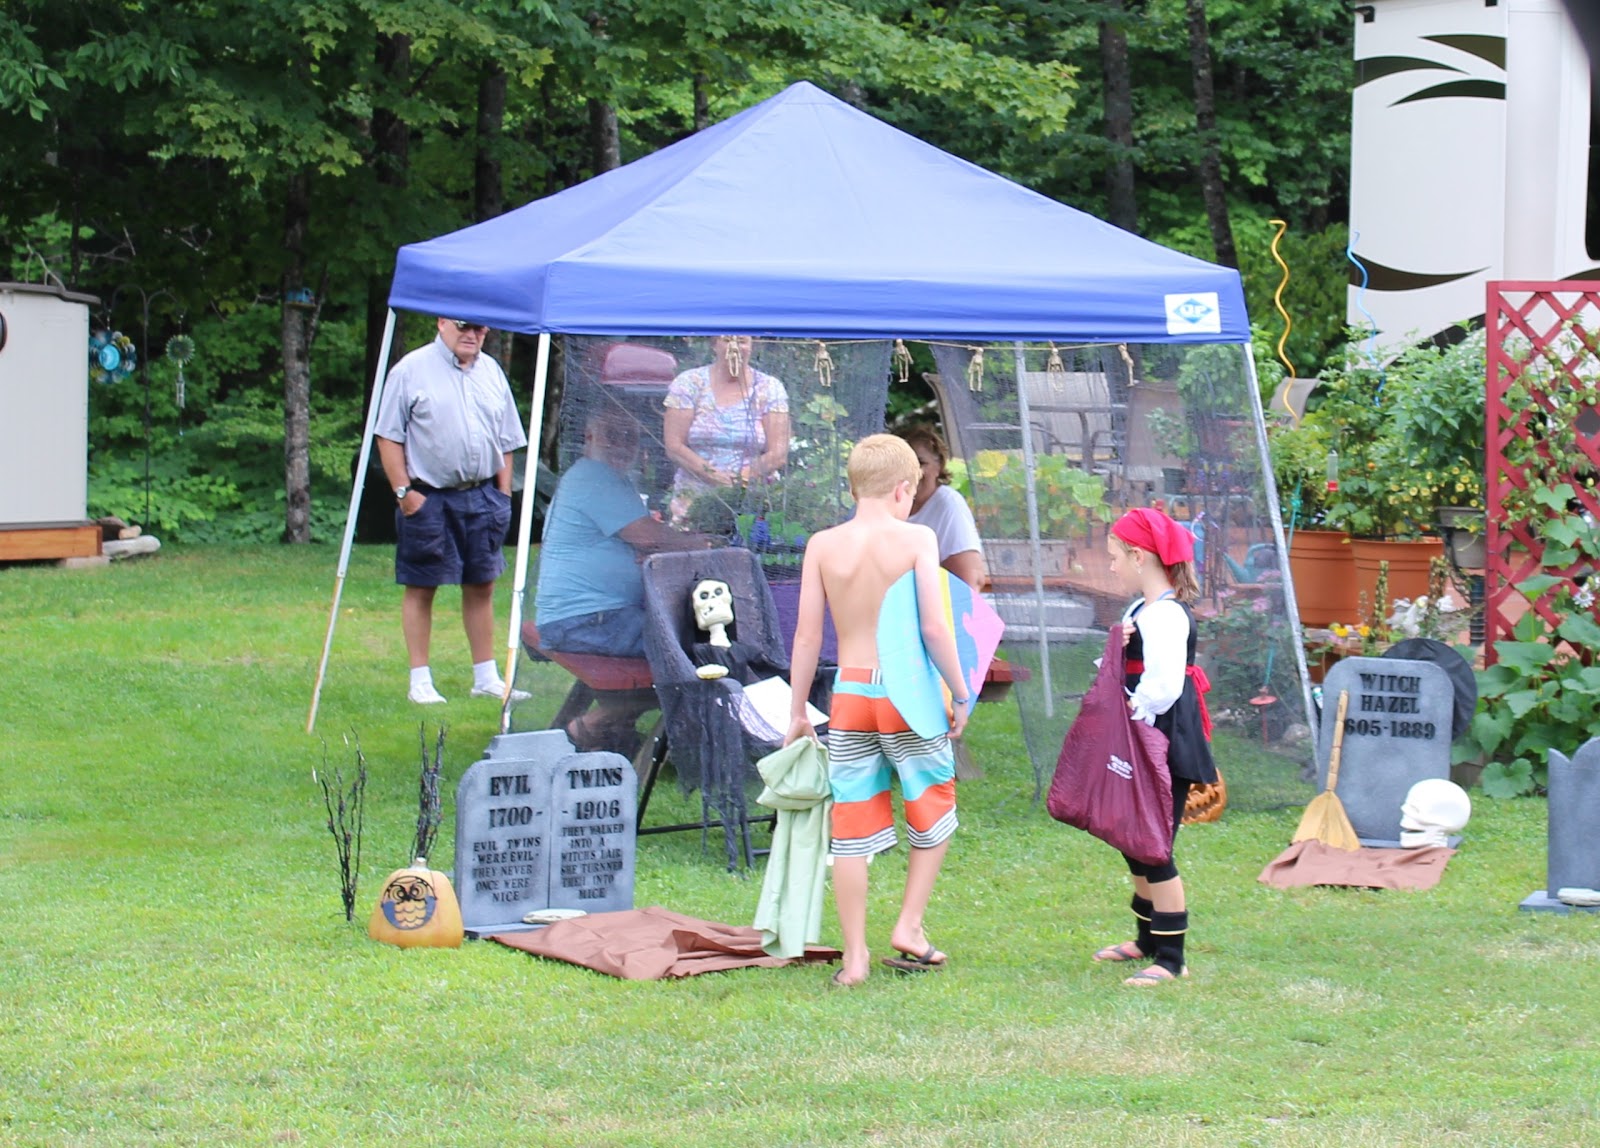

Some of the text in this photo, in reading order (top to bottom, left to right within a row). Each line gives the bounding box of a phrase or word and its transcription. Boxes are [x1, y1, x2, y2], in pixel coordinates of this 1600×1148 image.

[1359, 673, 1421, 694] WITCH
[1361, 694, 1420, 714] HAZEL
[566, 767, 623, 789] TWINS
[490, 774, 531, 797] EVIL
[561, 823, 624, 837] THEY WALKED
[473, 836, 541, 852] EVIL TWINS
[569, 836, 605, 849] INTO A
[600, 848, 622, 860] LAIR
[472, 864, 532, 879] THEY NEVER
[561, 864, 577, 876] SHE
[475, 878, 530, 893] ONCE WERE
[592, 874, 614, 886] INTO
[492, 890, 520, 902] NICE
[578, 887, 606, 899] MICE
